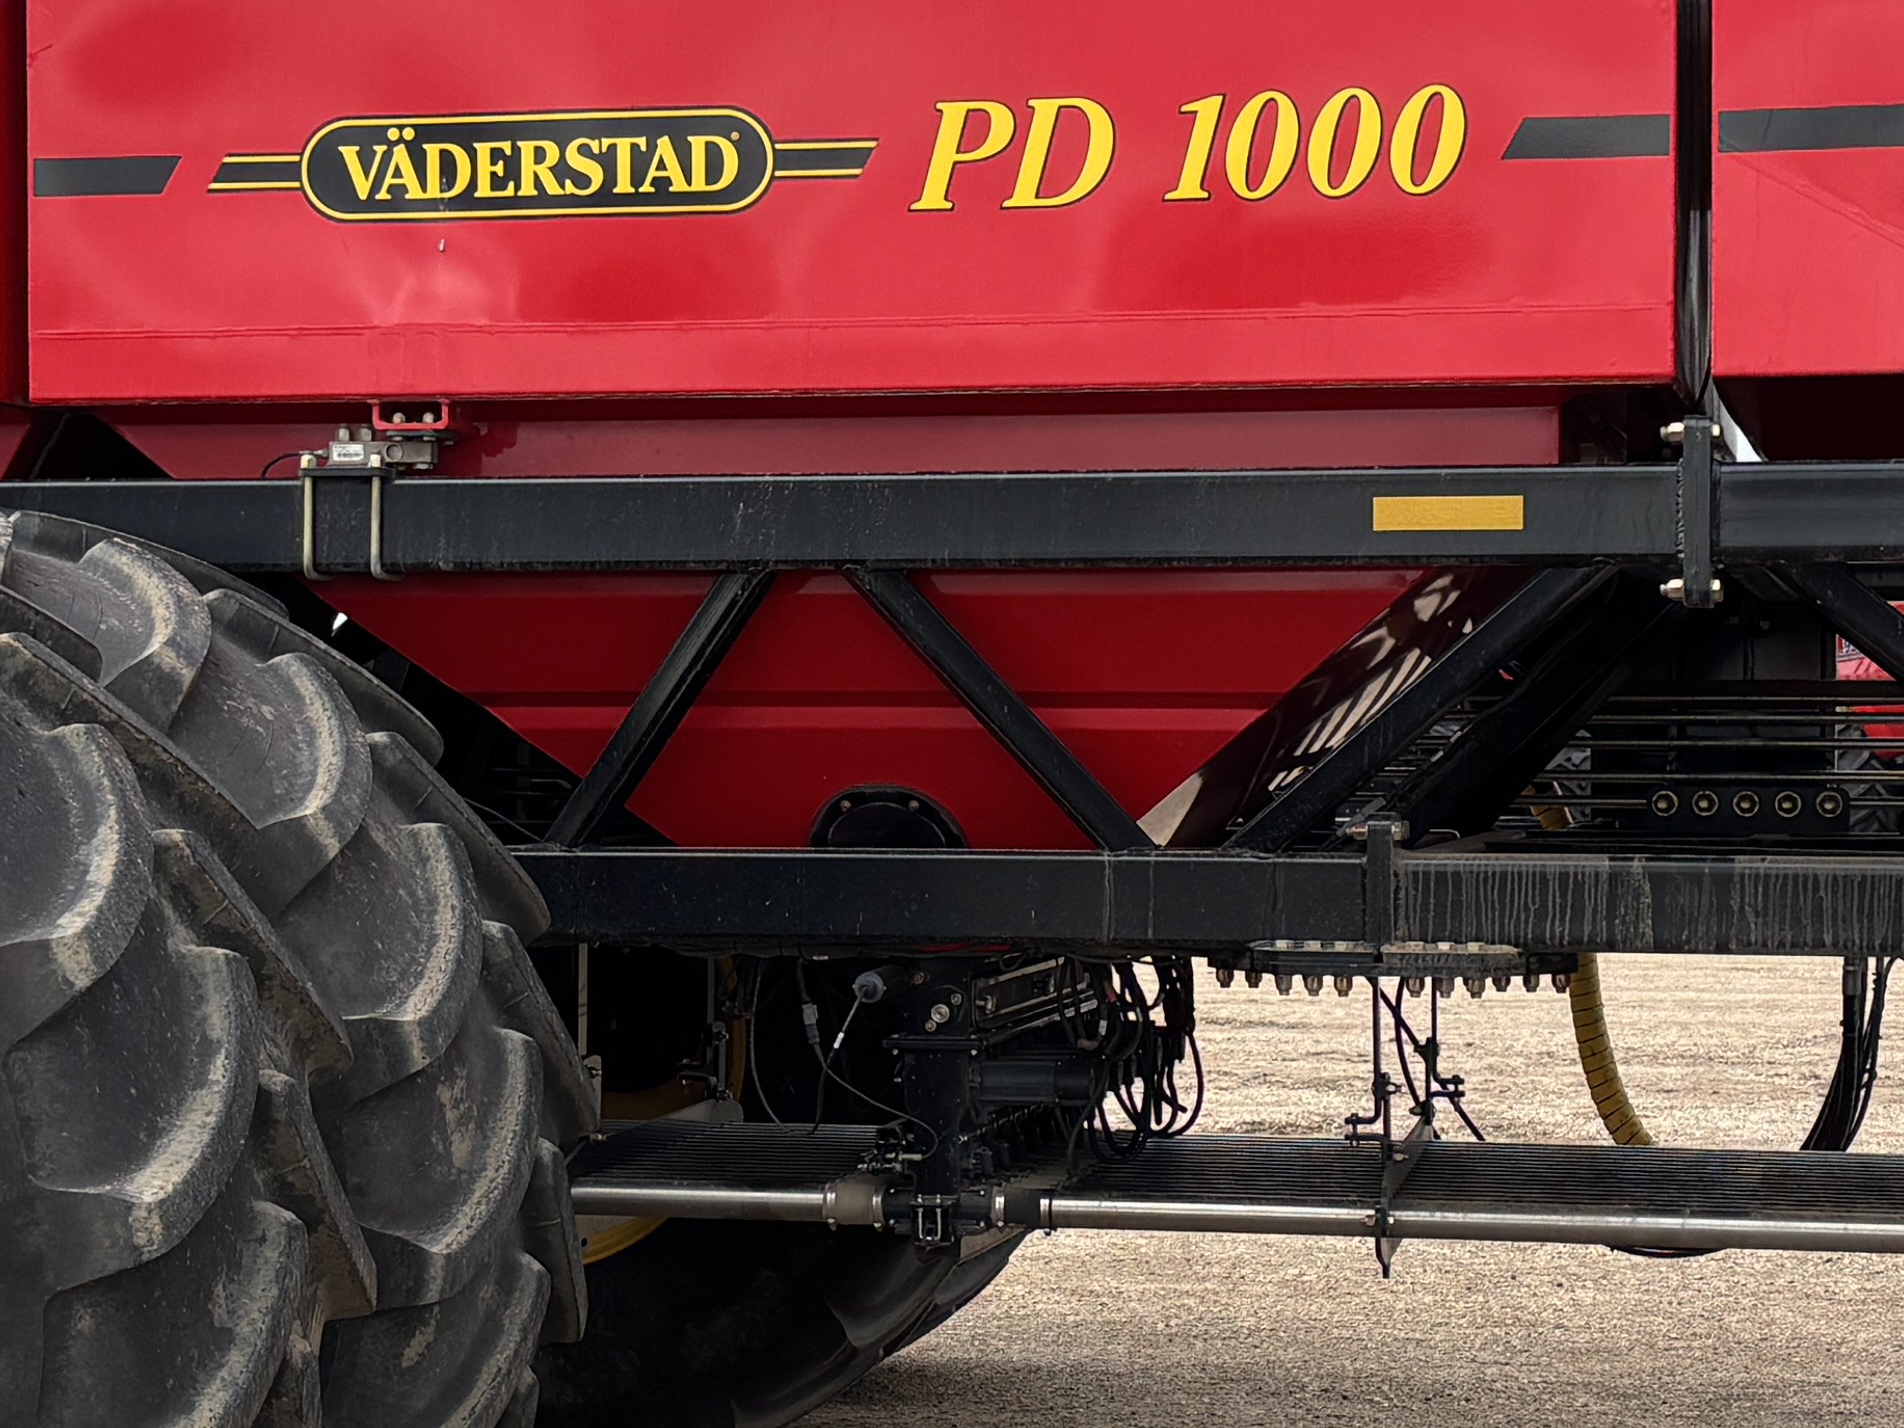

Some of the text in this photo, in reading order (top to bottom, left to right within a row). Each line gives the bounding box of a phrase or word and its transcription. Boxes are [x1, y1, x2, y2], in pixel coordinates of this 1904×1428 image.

[338, 127, 740, 201] VÄDERSTAD
[907, 83, 1468, 212] PD 1000
